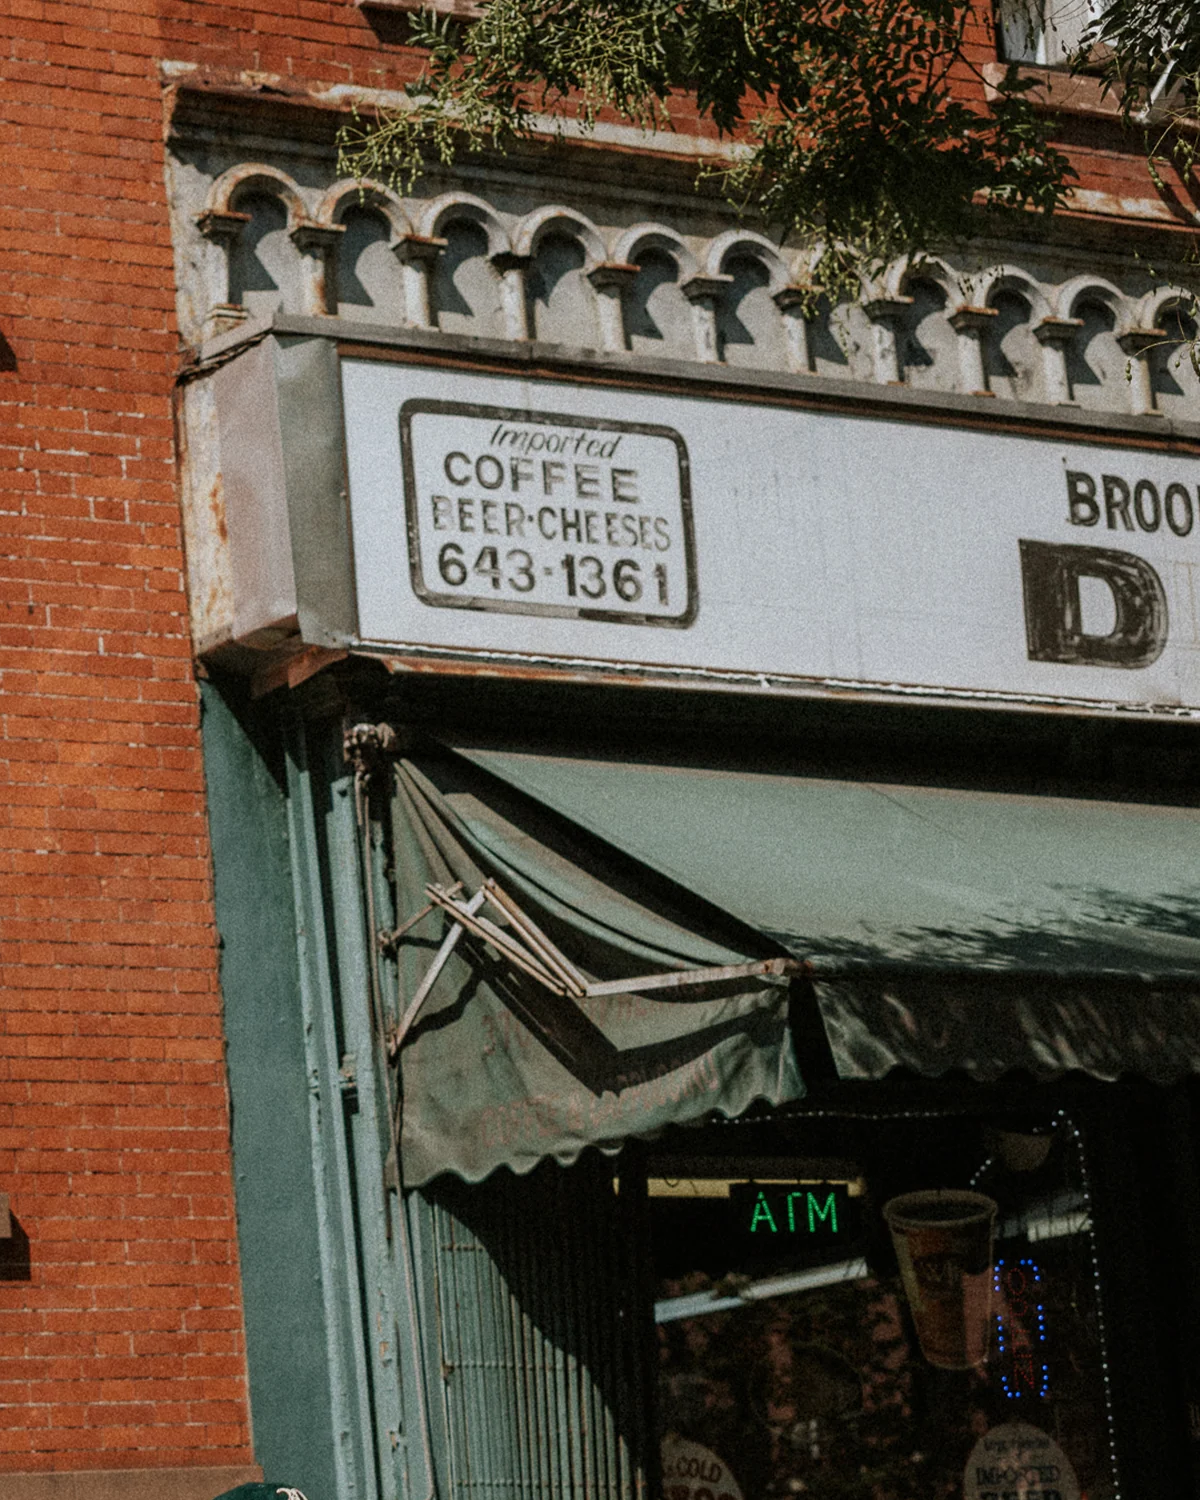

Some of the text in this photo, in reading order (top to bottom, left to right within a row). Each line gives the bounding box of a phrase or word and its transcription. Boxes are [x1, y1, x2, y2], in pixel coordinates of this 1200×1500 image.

[489, 424, 622, 460] Imported
[443, 450, 639, 504] COFFEE
[1065, 469, 1200, 538] BROO
[751, 1191, 838, 1233] ATM
[676, 1456, 722, 1483] COLD
